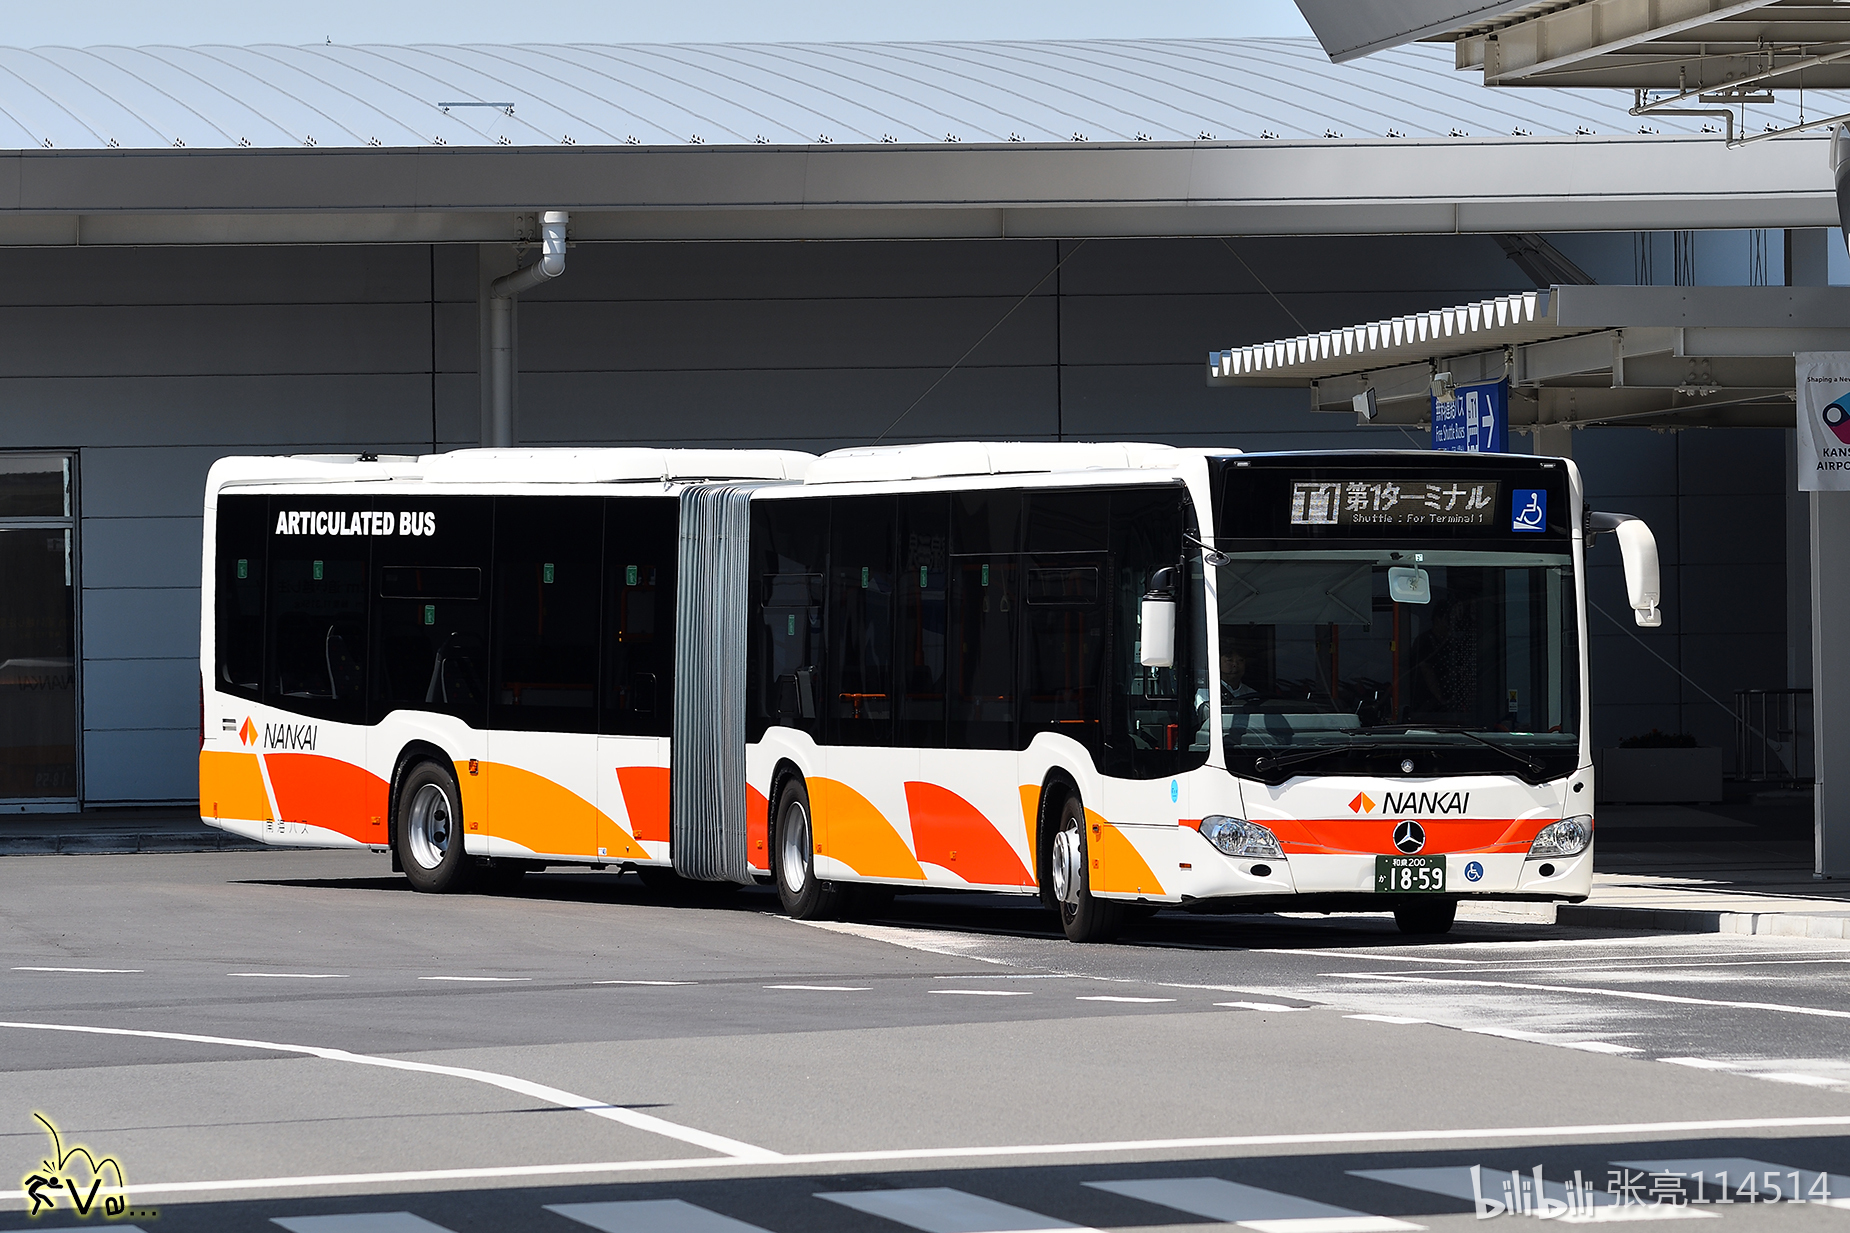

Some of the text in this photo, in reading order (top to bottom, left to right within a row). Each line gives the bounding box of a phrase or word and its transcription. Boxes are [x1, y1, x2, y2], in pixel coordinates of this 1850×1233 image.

[1807, 376, 1832, 384] Shaping
[1435, 425, 1443, 442] Free
[1443, 423, 1455, 441] Shuttle
[1296, 485, 1337, 521] T1
[1344, 481, 1492, 512] 第1ターミナル
[275, 511, 436, 537] ARTICULATED BUS
[1352, 513, 1393, 523] Shuttle
[1406, 513, 1426, 523] For
[1429, 513, 1474, 523] Terminal
[1478, 513, 1484, 523] 1
[263, 722, 318, 751] NANKAI
[1382, 791, 1470, 814] NANKAI
[1390, 867, 1443, 890] 18-59
